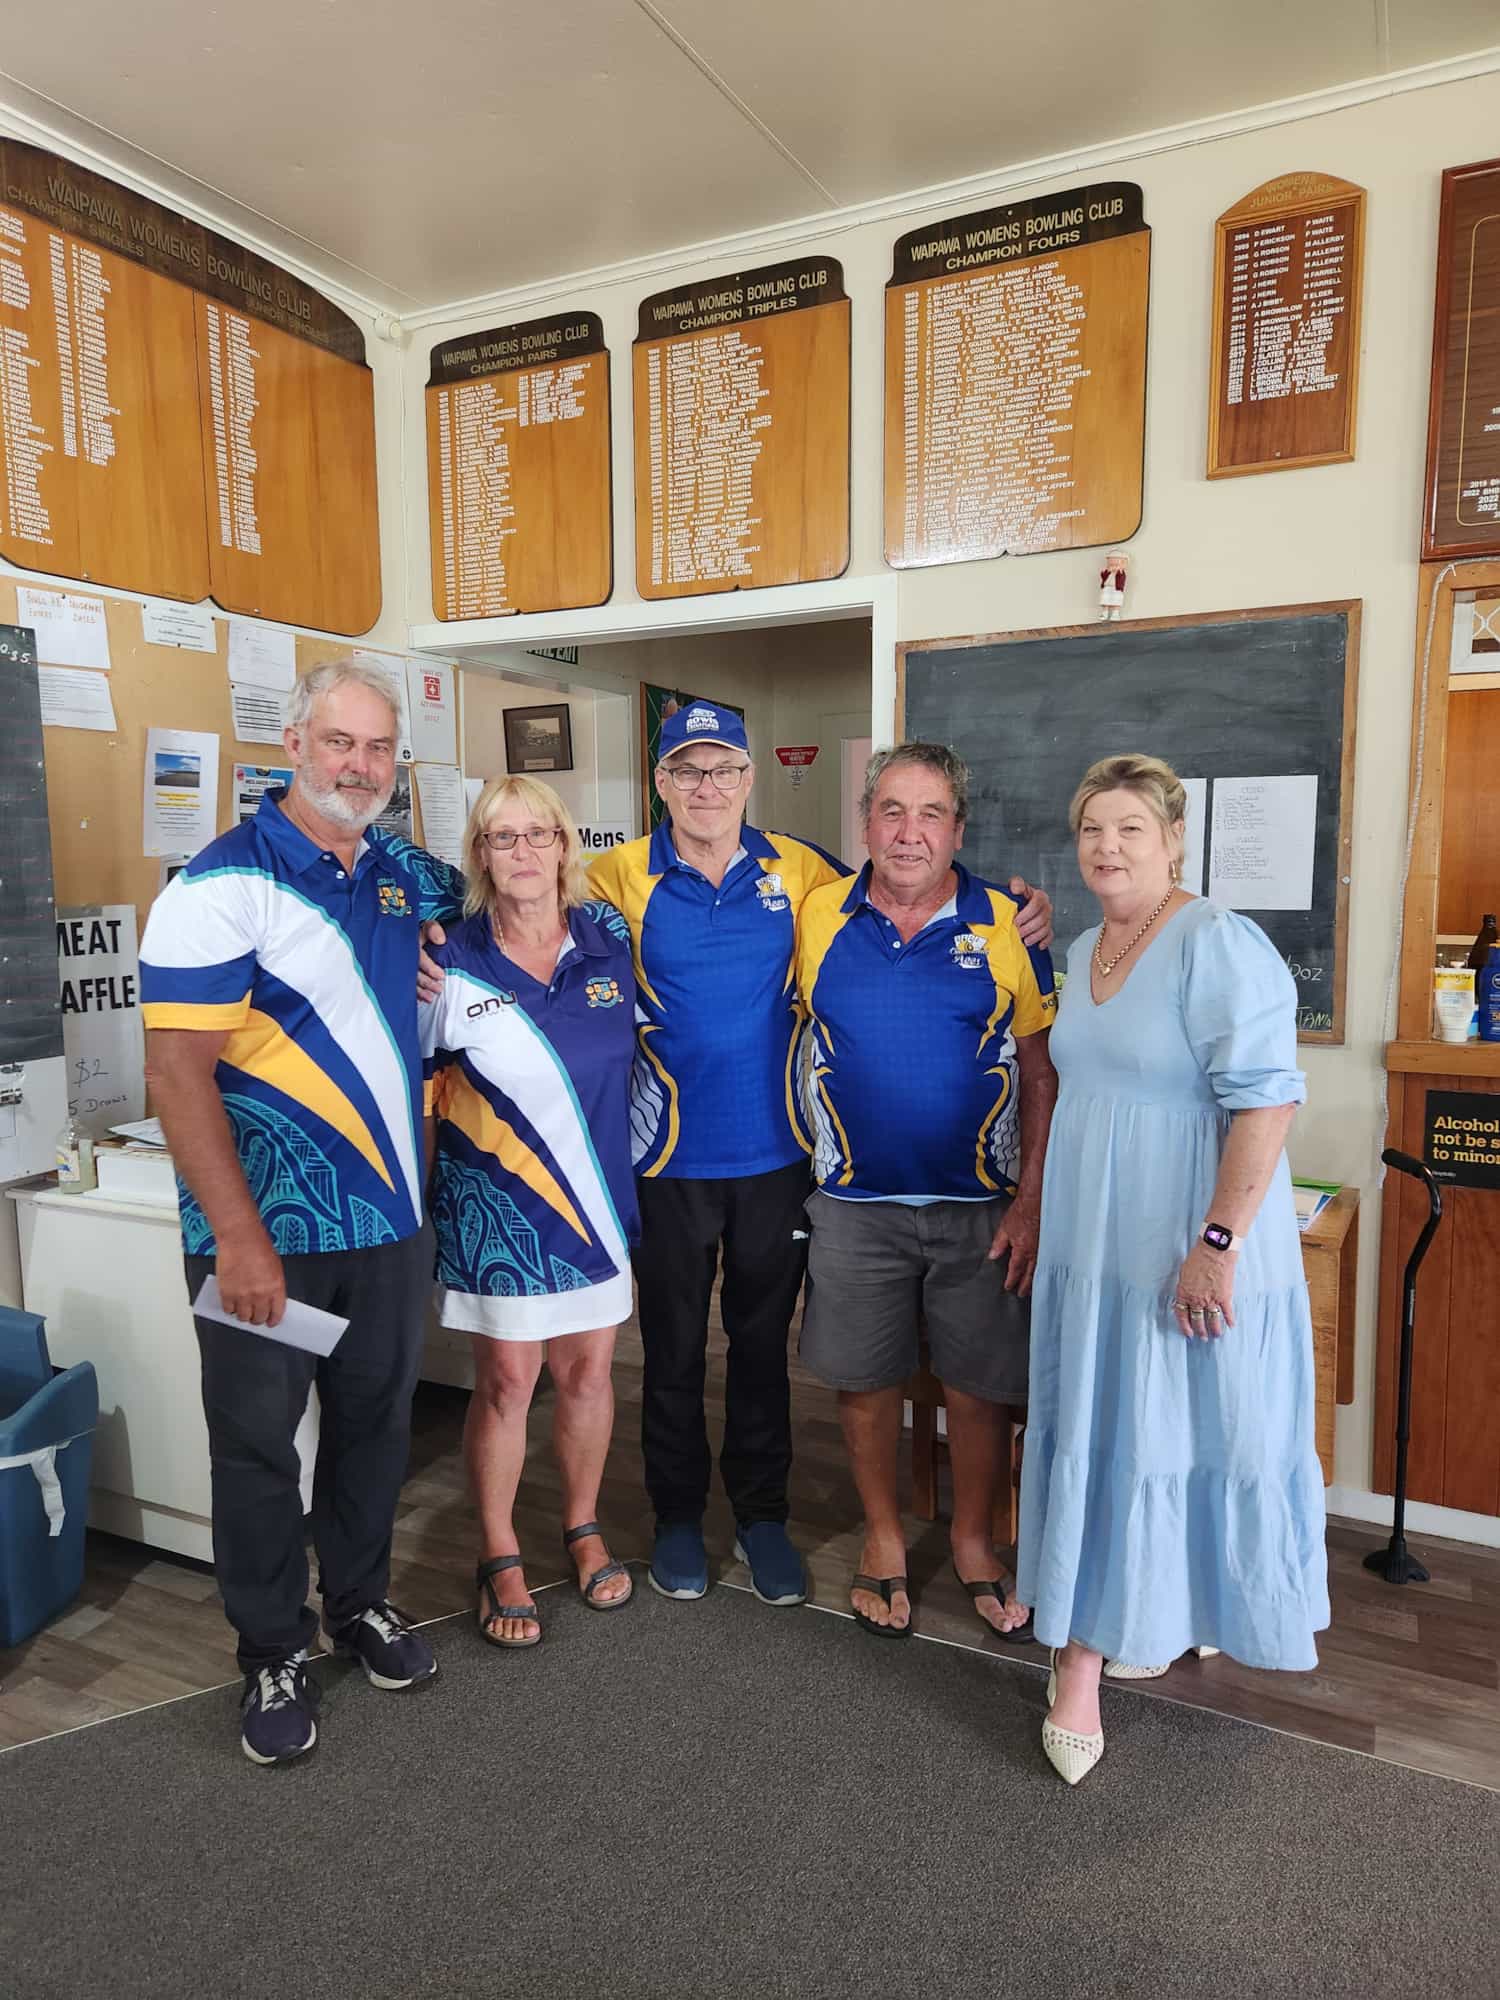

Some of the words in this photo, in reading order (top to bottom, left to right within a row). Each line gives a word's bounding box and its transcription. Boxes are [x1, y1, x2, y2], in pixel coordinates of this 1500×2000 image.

[8, 185, 82, 223] CHAMPION
[90, 224, 144, 256] SINGLES
[911, 236, 960, 262] WAIPAWA
[966, 222, 1020, 249] WOMENS
[1026, 208, 1084, 235] BOWLING
[1088, 198, 1124, 220] CLUB
[48, 176, 122, 230] WAIPAWA
[129, 216, 200, 267] WOMENS
[207, 254, 272, 301] BOWLING
[278, 290, 312, 320] CLUB
[946, 243, 1022, 270] CHAMPION
[1028, 230, 1080, 252] FOURS
[653, 300, 694, 320] WAIPAWA
[698, 289, 744, 310] WOMENS
[748, 278, 795, 300] BOWLING
[800, 270, 828, 290] CLUB
[680, 308, 742, 330] CHAMPION
[748, 296, 798, 315] TRIPLES
[442, 348, 478, 366] WAIPAWA
[480, 338, 518, 358] WOMENS
[522, 330, 562, 350] BOWLING
[565, 324, 589, 341] CLUB
[470, 355, 524, 374] CHAMPION
[528, 348, 558, 363] PAIRS
[578, 827, 624, 848] Mens
[62, 975, 136, 1014] AFFLE
[73, 1058, 109, 1088] $2
[1433, 1133, 1460, 1146] not
[1465, 1134, 1487, 1148] be
[1434, 1116, 1500, 1132] Alcohol
[1432, 1147, 1450, 1160] to
